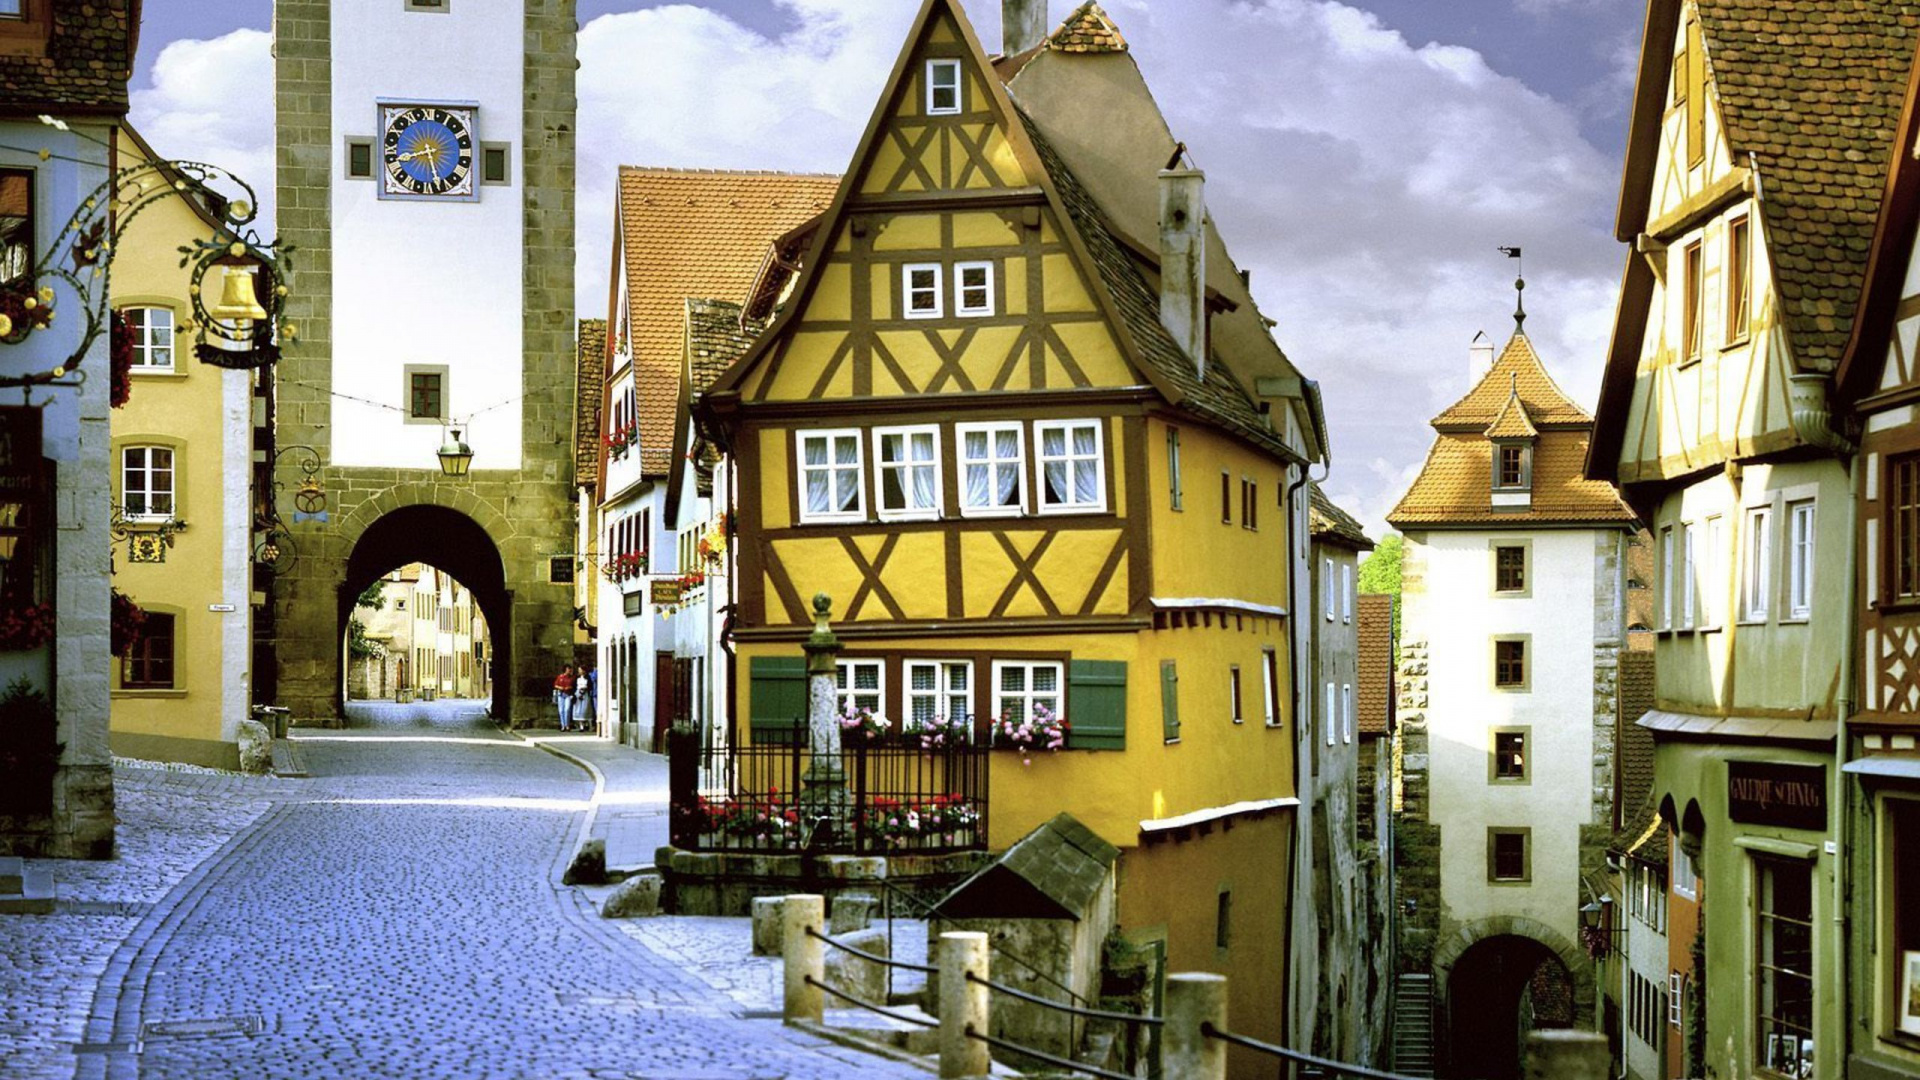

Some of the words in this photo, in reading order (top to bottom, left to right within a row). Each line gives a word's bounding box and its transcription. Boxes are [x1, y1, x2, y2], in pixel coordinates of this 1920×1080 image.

[403, 112, 416, 125] XI
[421, 108, 435, 120] XII
[443, 115, 451, 126] I
[390, 125, 403, 136] X
[1730, 777, 1772, 809] GALERIE
